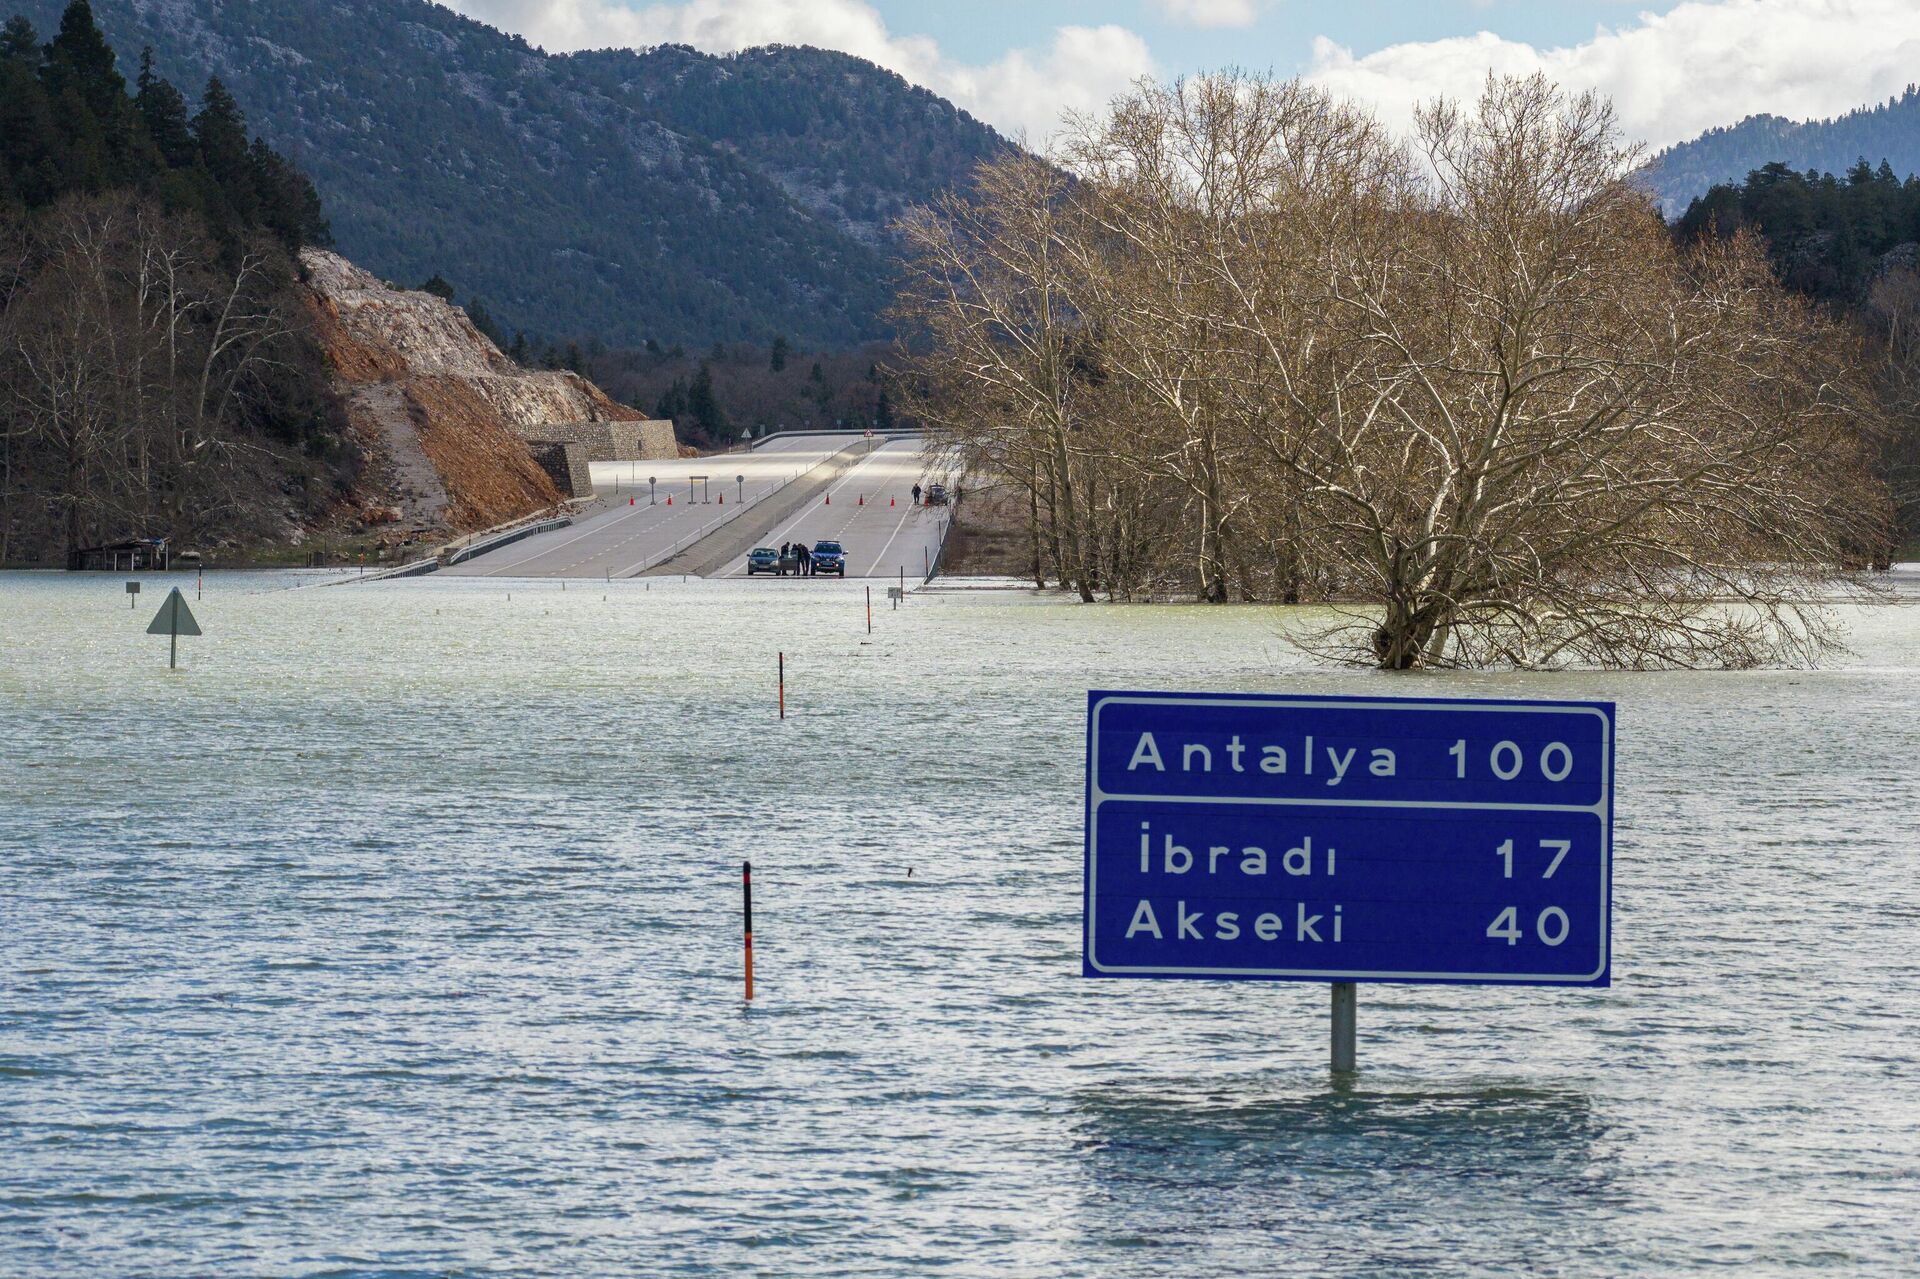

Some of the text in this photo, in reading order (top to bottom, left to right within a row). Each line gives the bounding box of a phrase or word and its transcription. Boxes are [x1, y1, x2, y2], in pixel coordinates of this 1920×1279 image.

[1128, 732, 1573, 785] Antalya 100
[1140, 822, 1571, 879] İbradı 17
[1125, 899, 1570, 947] Akseki 40
